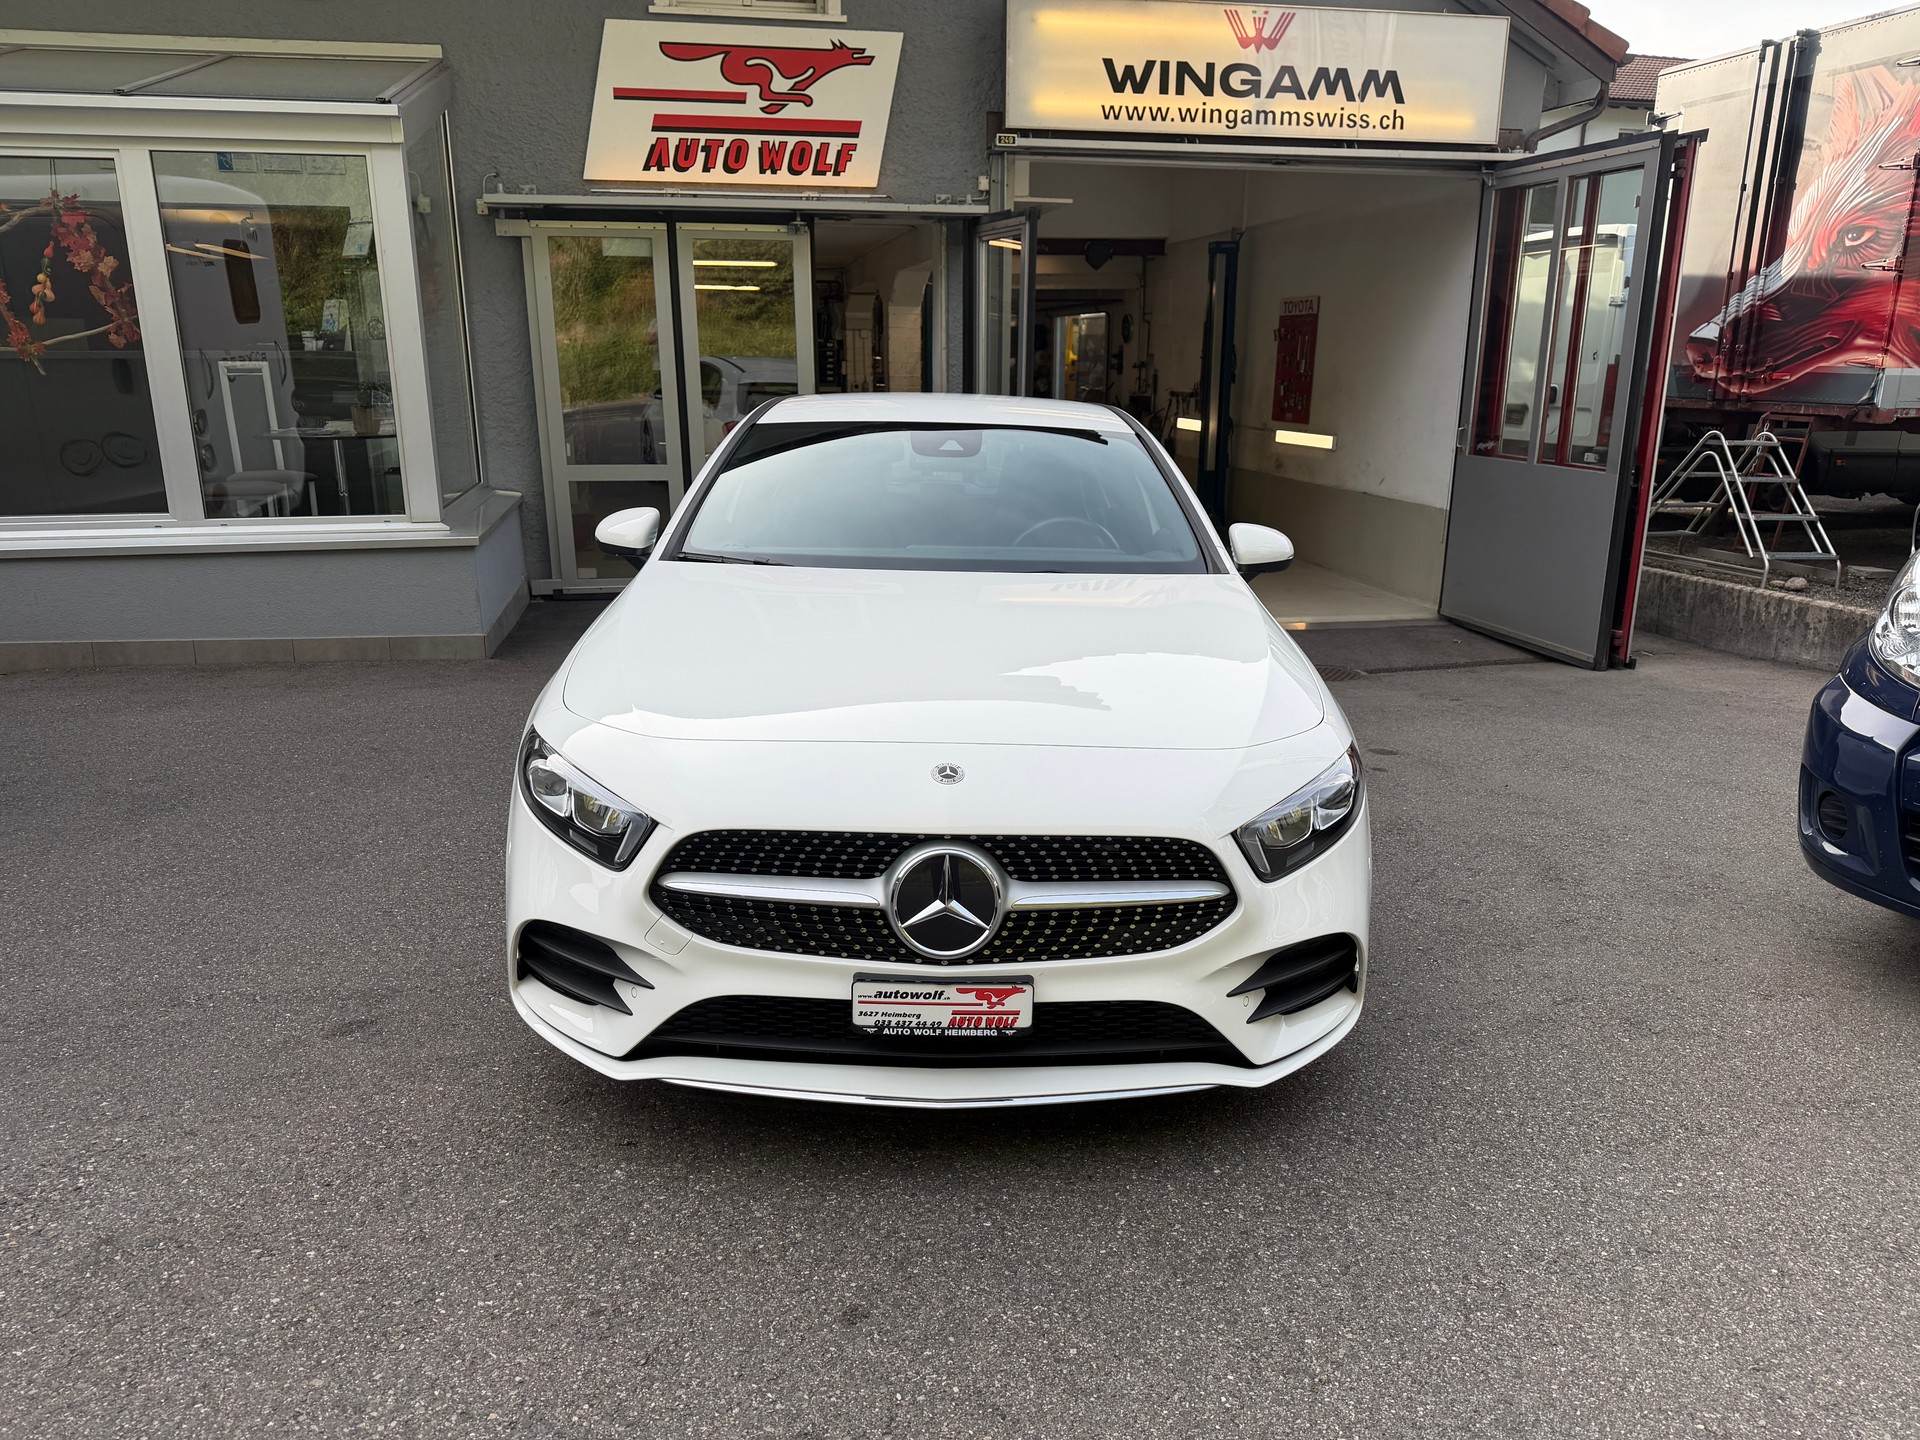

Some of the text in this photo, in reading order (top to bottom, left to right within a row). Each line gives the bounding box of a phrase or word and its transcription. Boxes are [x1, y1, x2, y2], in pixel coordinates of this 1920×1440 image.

[1101, 57, 1405, 104] WINGAMM
[1100, 102, 1405, 131] www.wingammswiss.ch
[642, 137, 857, 177] AUTO WOLF
[1283, 299, 1314, 314] TOYOTA
[857, 989, 951, 1001] www.autowolf.ch
[857, 1010, 922, 1020] 3627 Heimberg
[873, 1019, 893, 1028] 033
[894, 1020, 913, 1028] 437
[914, 1020, 928, 1028] 44
[947, 1016, 1019, 1029] AUTO WOLF
[882, 1028, 998, 1037] AUTO WOLF HEIMBERG
